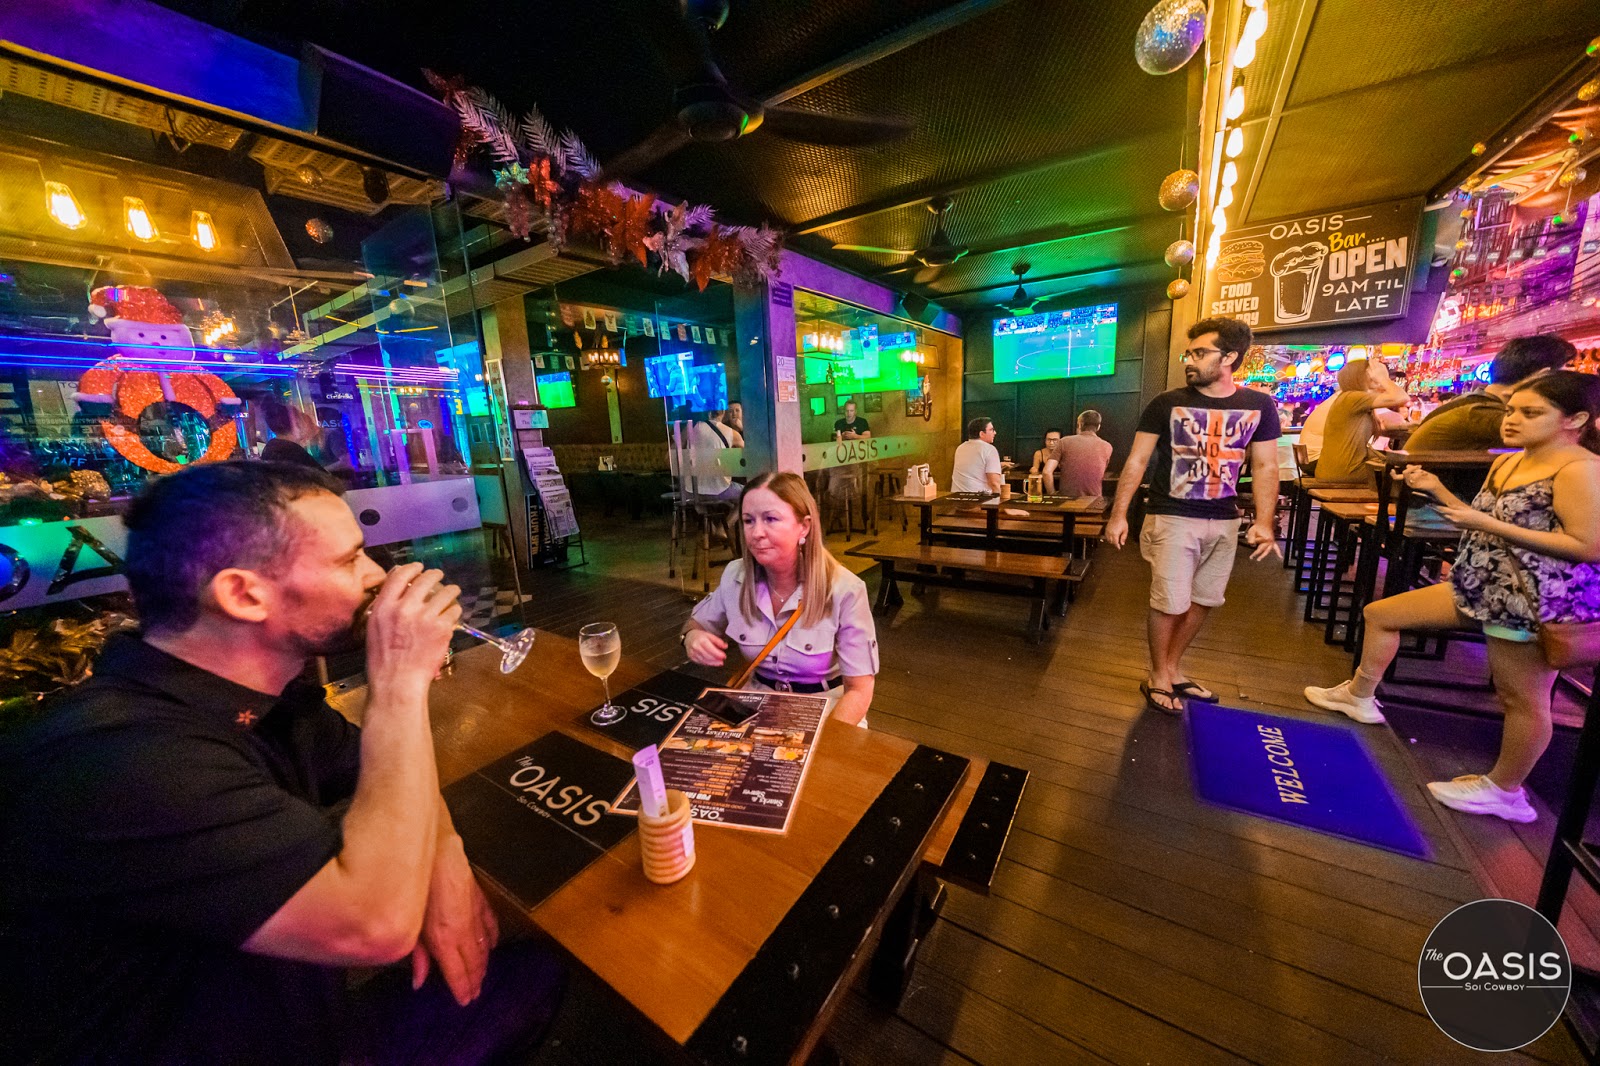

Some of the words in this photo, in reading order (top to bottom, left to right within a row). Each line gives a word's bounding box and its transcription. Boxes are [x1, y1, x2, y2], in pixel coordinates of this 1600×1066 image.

[1270, 215, 1343, 240] OASIS
[1328, 236, 1408, 281] OPEN
[1221, 282, 1252, 299] FOOD
[1322, 279, 1369, 297] 9AM
[1375, 278, 1404, 291] TIL
[1211, 297, 1259, 315] SERVED
[1335, 295, 1389, 313] LATE
[1181, 418, 1253, 437] FOLLOW
[836, 439, 878, 463] OASIS
[1197, 441, 1219, 457] NO
[630, 698, 682, 722] SIS
[515, 755, 534, 767] The
[1257, 724, 1310, 805] WELCOME
[510, 765, 611, 826] OASIS
[691, 808, 720, 820] OAS
